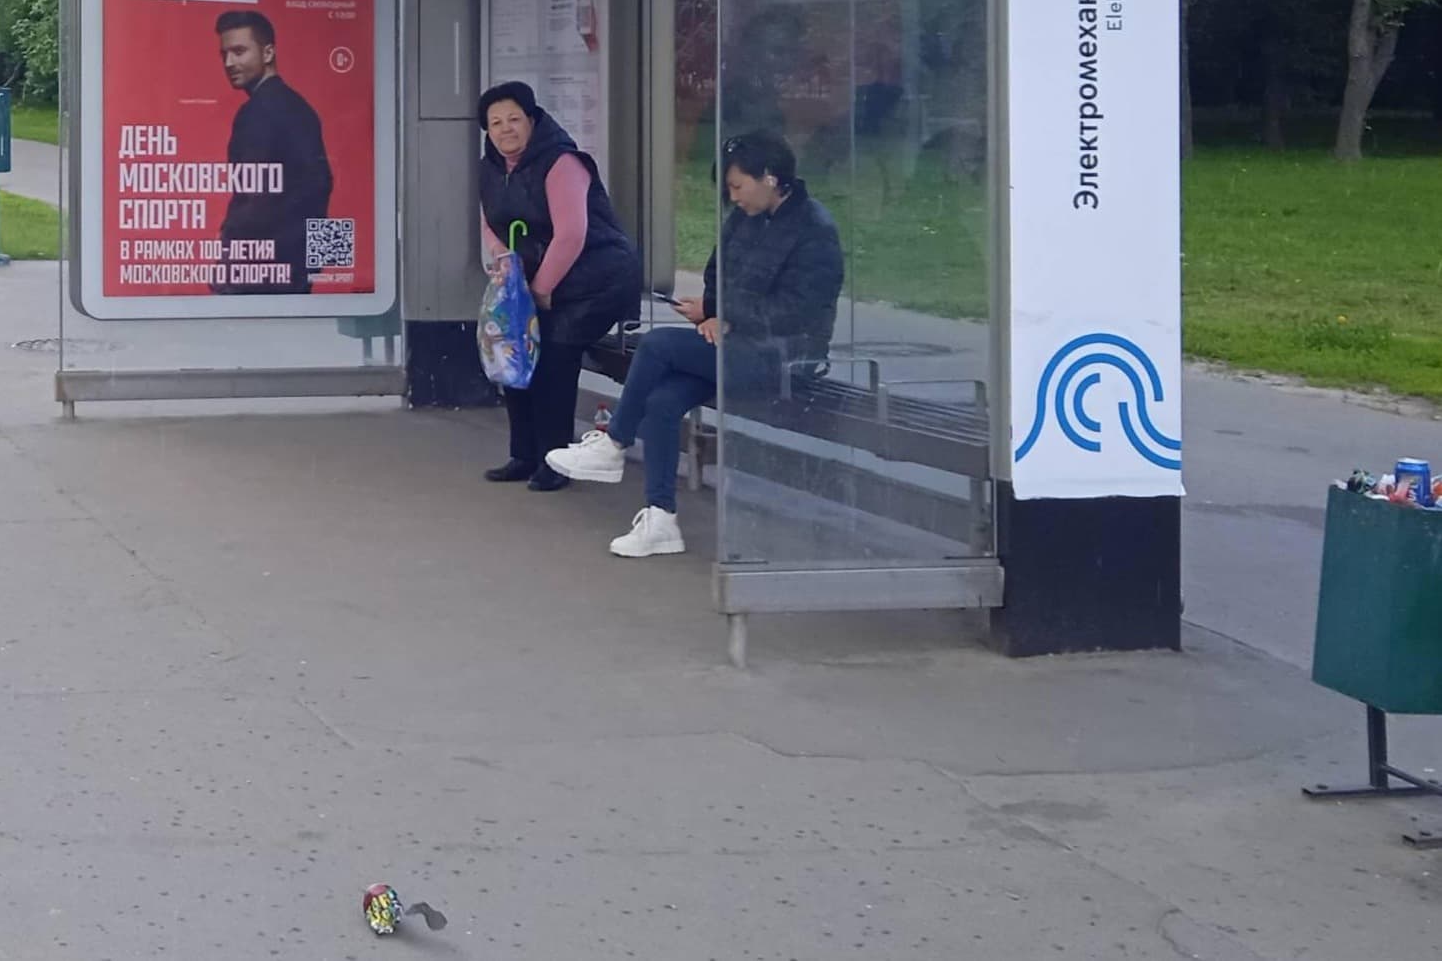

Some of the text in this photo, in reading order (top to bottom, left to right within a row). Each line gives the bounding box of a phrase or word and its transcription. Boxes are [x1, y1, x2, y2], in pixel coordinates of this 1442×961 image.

[118, 125, 177, 159] ДЕНЬ
[119, 163, 284, 193] МОСКОВСКОГО
[118, 199, 207, 230] СПОРТА
[120, 240, 276, 260] В РАМКАХ 100-ЛЕТИЯ
[120, 263, 292, 284] МОСКОВСКОГО СПОРТА!
